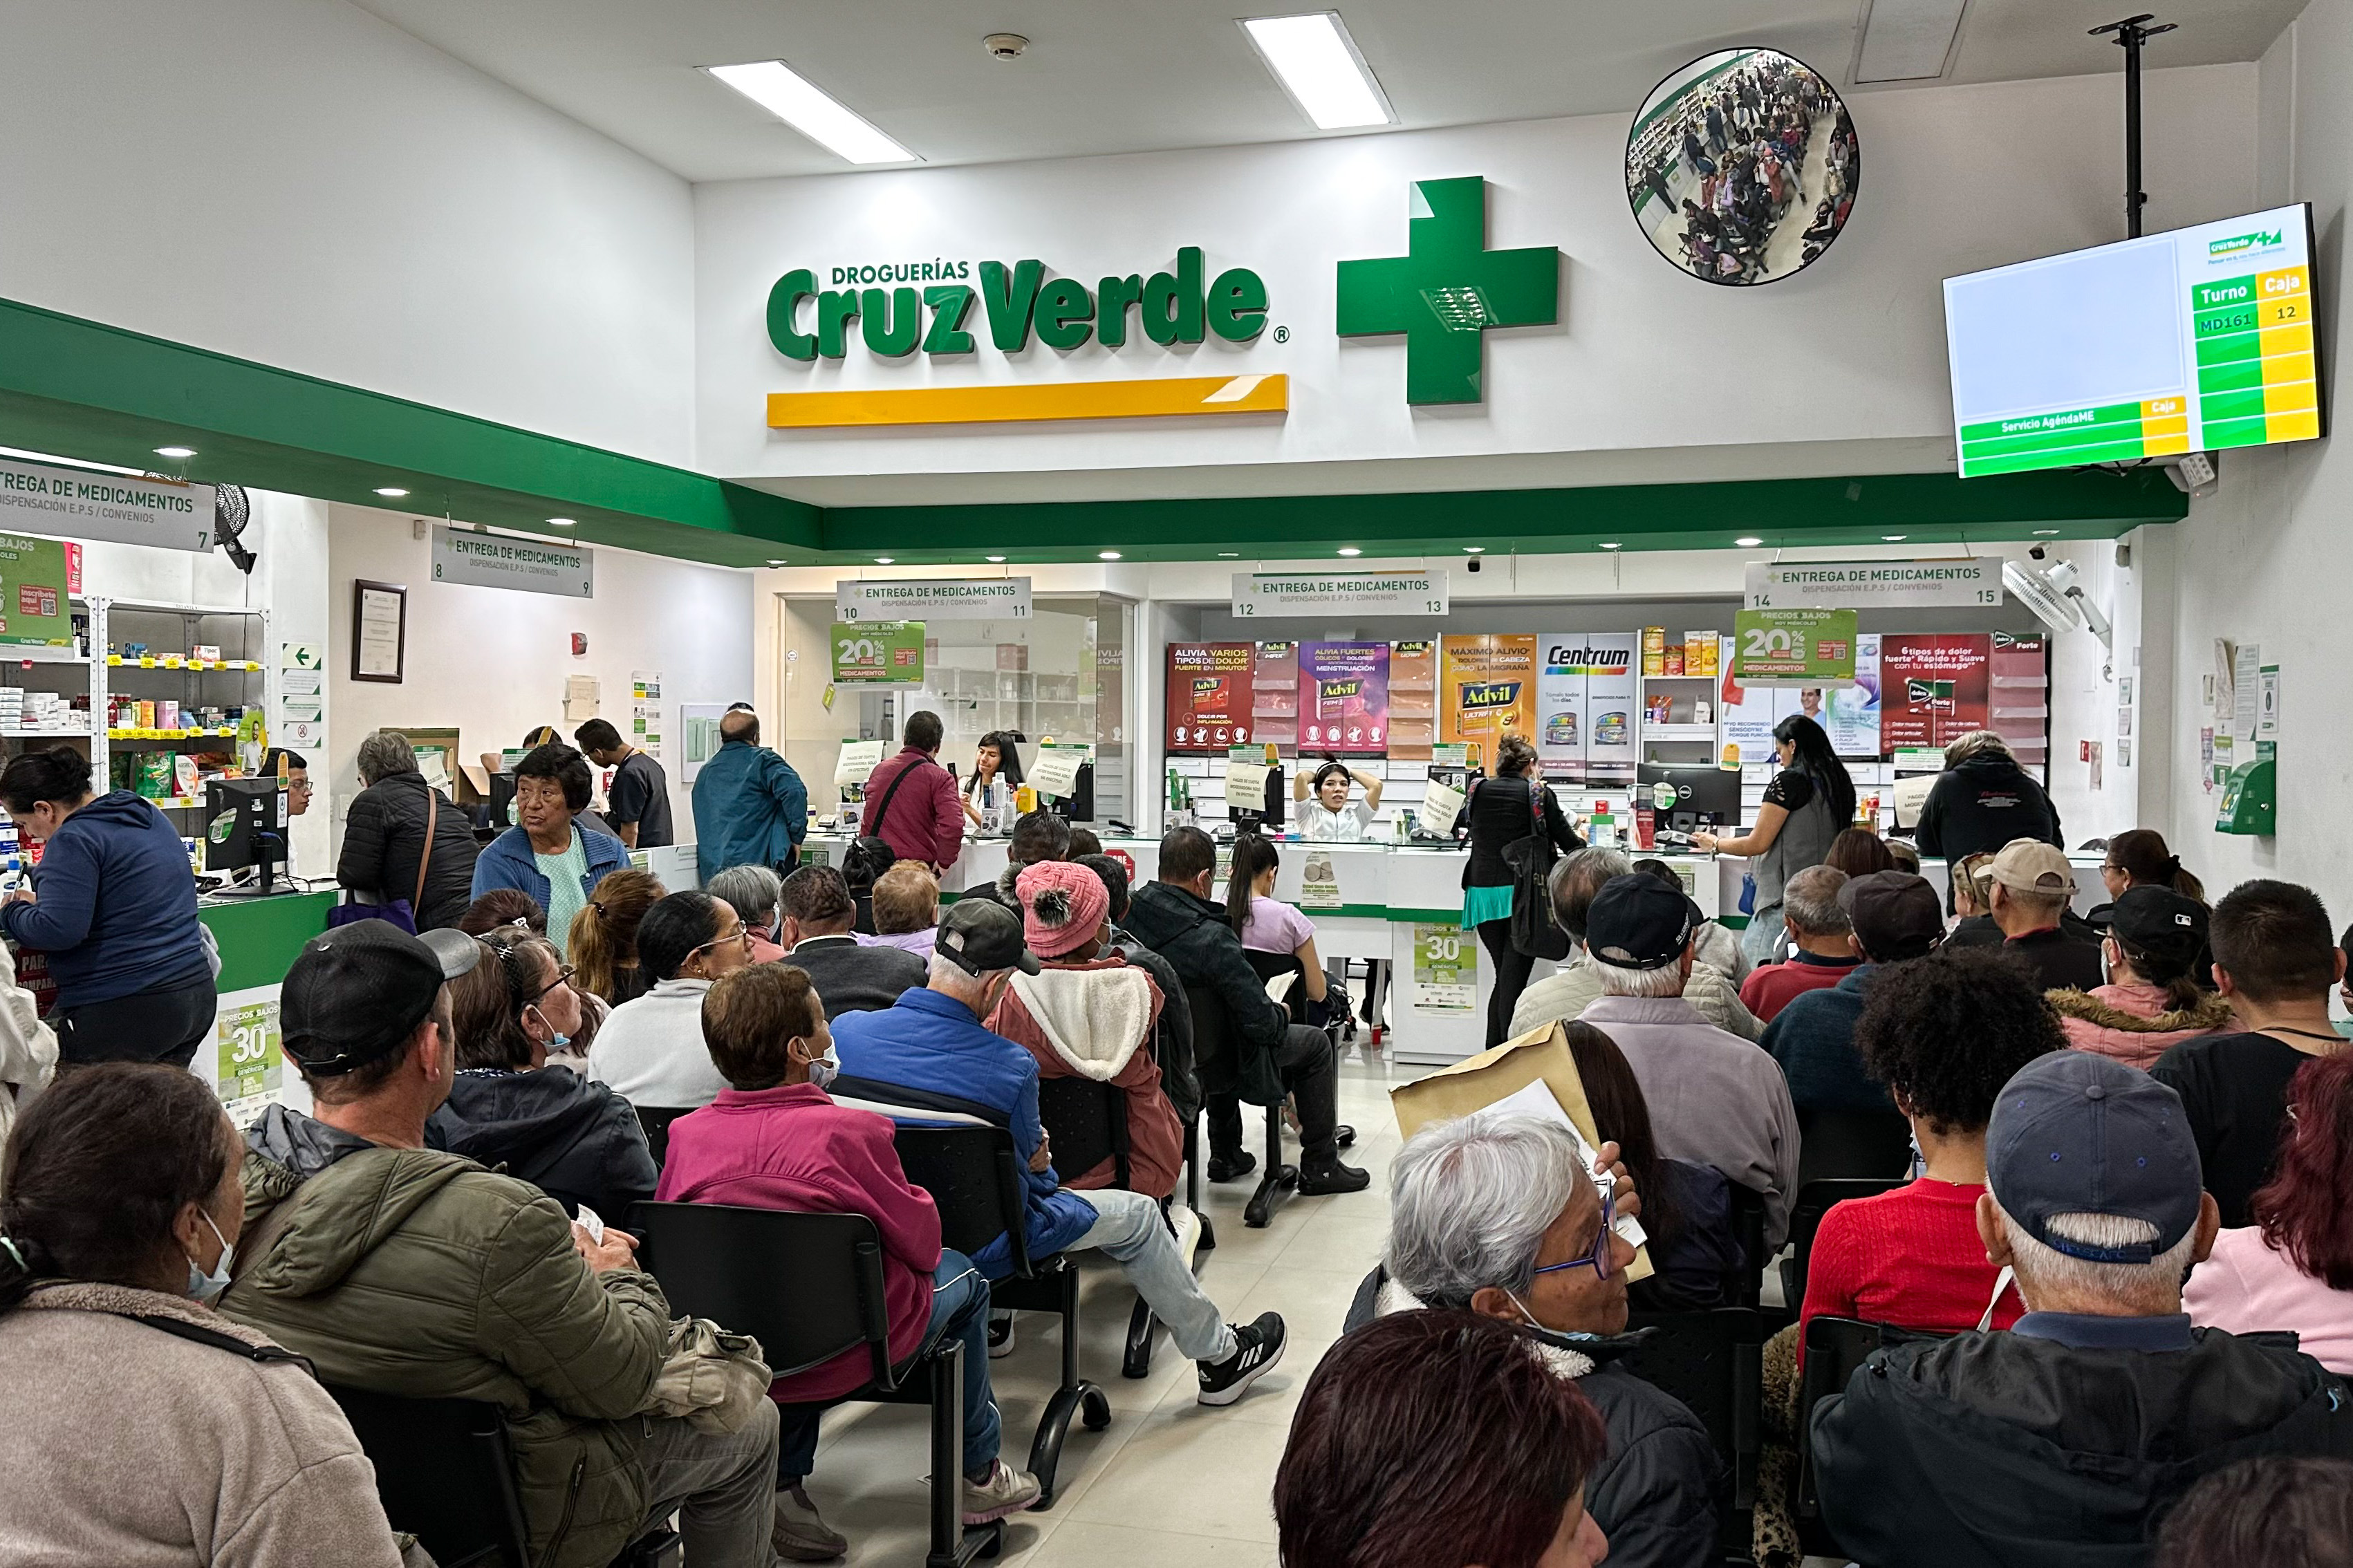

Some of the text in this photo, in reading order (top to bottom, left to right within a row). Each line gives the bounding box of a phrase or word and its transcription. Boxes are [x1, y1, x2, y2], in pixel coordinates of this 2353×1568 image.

[832, 258, 969, 286] DROGUERÍAS
[2201, 274, 2300, 304] Turno Caja
[2201, 306, 2296, 333] MD161 12
[2152, 400, 2175, 413] Caja
[2002, 419, 2040, 433] Servicio
[53, 479, 73, 497] DE
[77, 483, 193, 513] MEDICAMENTOS
[69, 501, 93, 516] E.P.S
[102, 507, 154, 523] CONVENIOS
[198, 532, 207, 548] 7
[456, 540, 580, 568] ENTREGA DE MEDICAMENTOS
[436, 564, 442, 577] 8
[469, 558, 509, 570] DISPENSACIÓN
[510, 563, 523, 572] E.P.S
[528, 566, 558, 577] CONVENIOS
[1783, 568, 1980, 583] ENTREGA DE MEDICAMENTOS
[584, 582, 588, 594] 9
[866, 586, 1015, 598] ENTREGA DE MEDICAMENTOS
[1263, 580, 1429, 593] ENTREGA DE MEDICAMENTOS
[1802, 584, 1861, 592] DISPENSACIÓN
[1892, 583, 1942, 591] CONVENIOS
[1280, 594, 1330, 602] DISPENSACIÓN
[1754, 595, 1770, 606] 14
[1977, 590, 1994, 602] 15
[844, 608, 857, 618] 10
[1013, 606, 1025, 616] 11
[1239, 604, 1254, 615] 12
[1426, 601, 1441, 612] 13
[1743, 628, 1791, 656] 20
[838, 639, 874, 664] 20
[1548, 646, 1630, 666] Centrum
[1194, 680, 1218, 690] Advil
[1323, 682, 1357, 696] Advil
[1464, 686, 1510, 704] Advil
[1426, 936, 1460, 960] 30
[225, 1007, 279, 1023] PRECIOS BAJOS
[232, 1024, 266, 1063] 30
